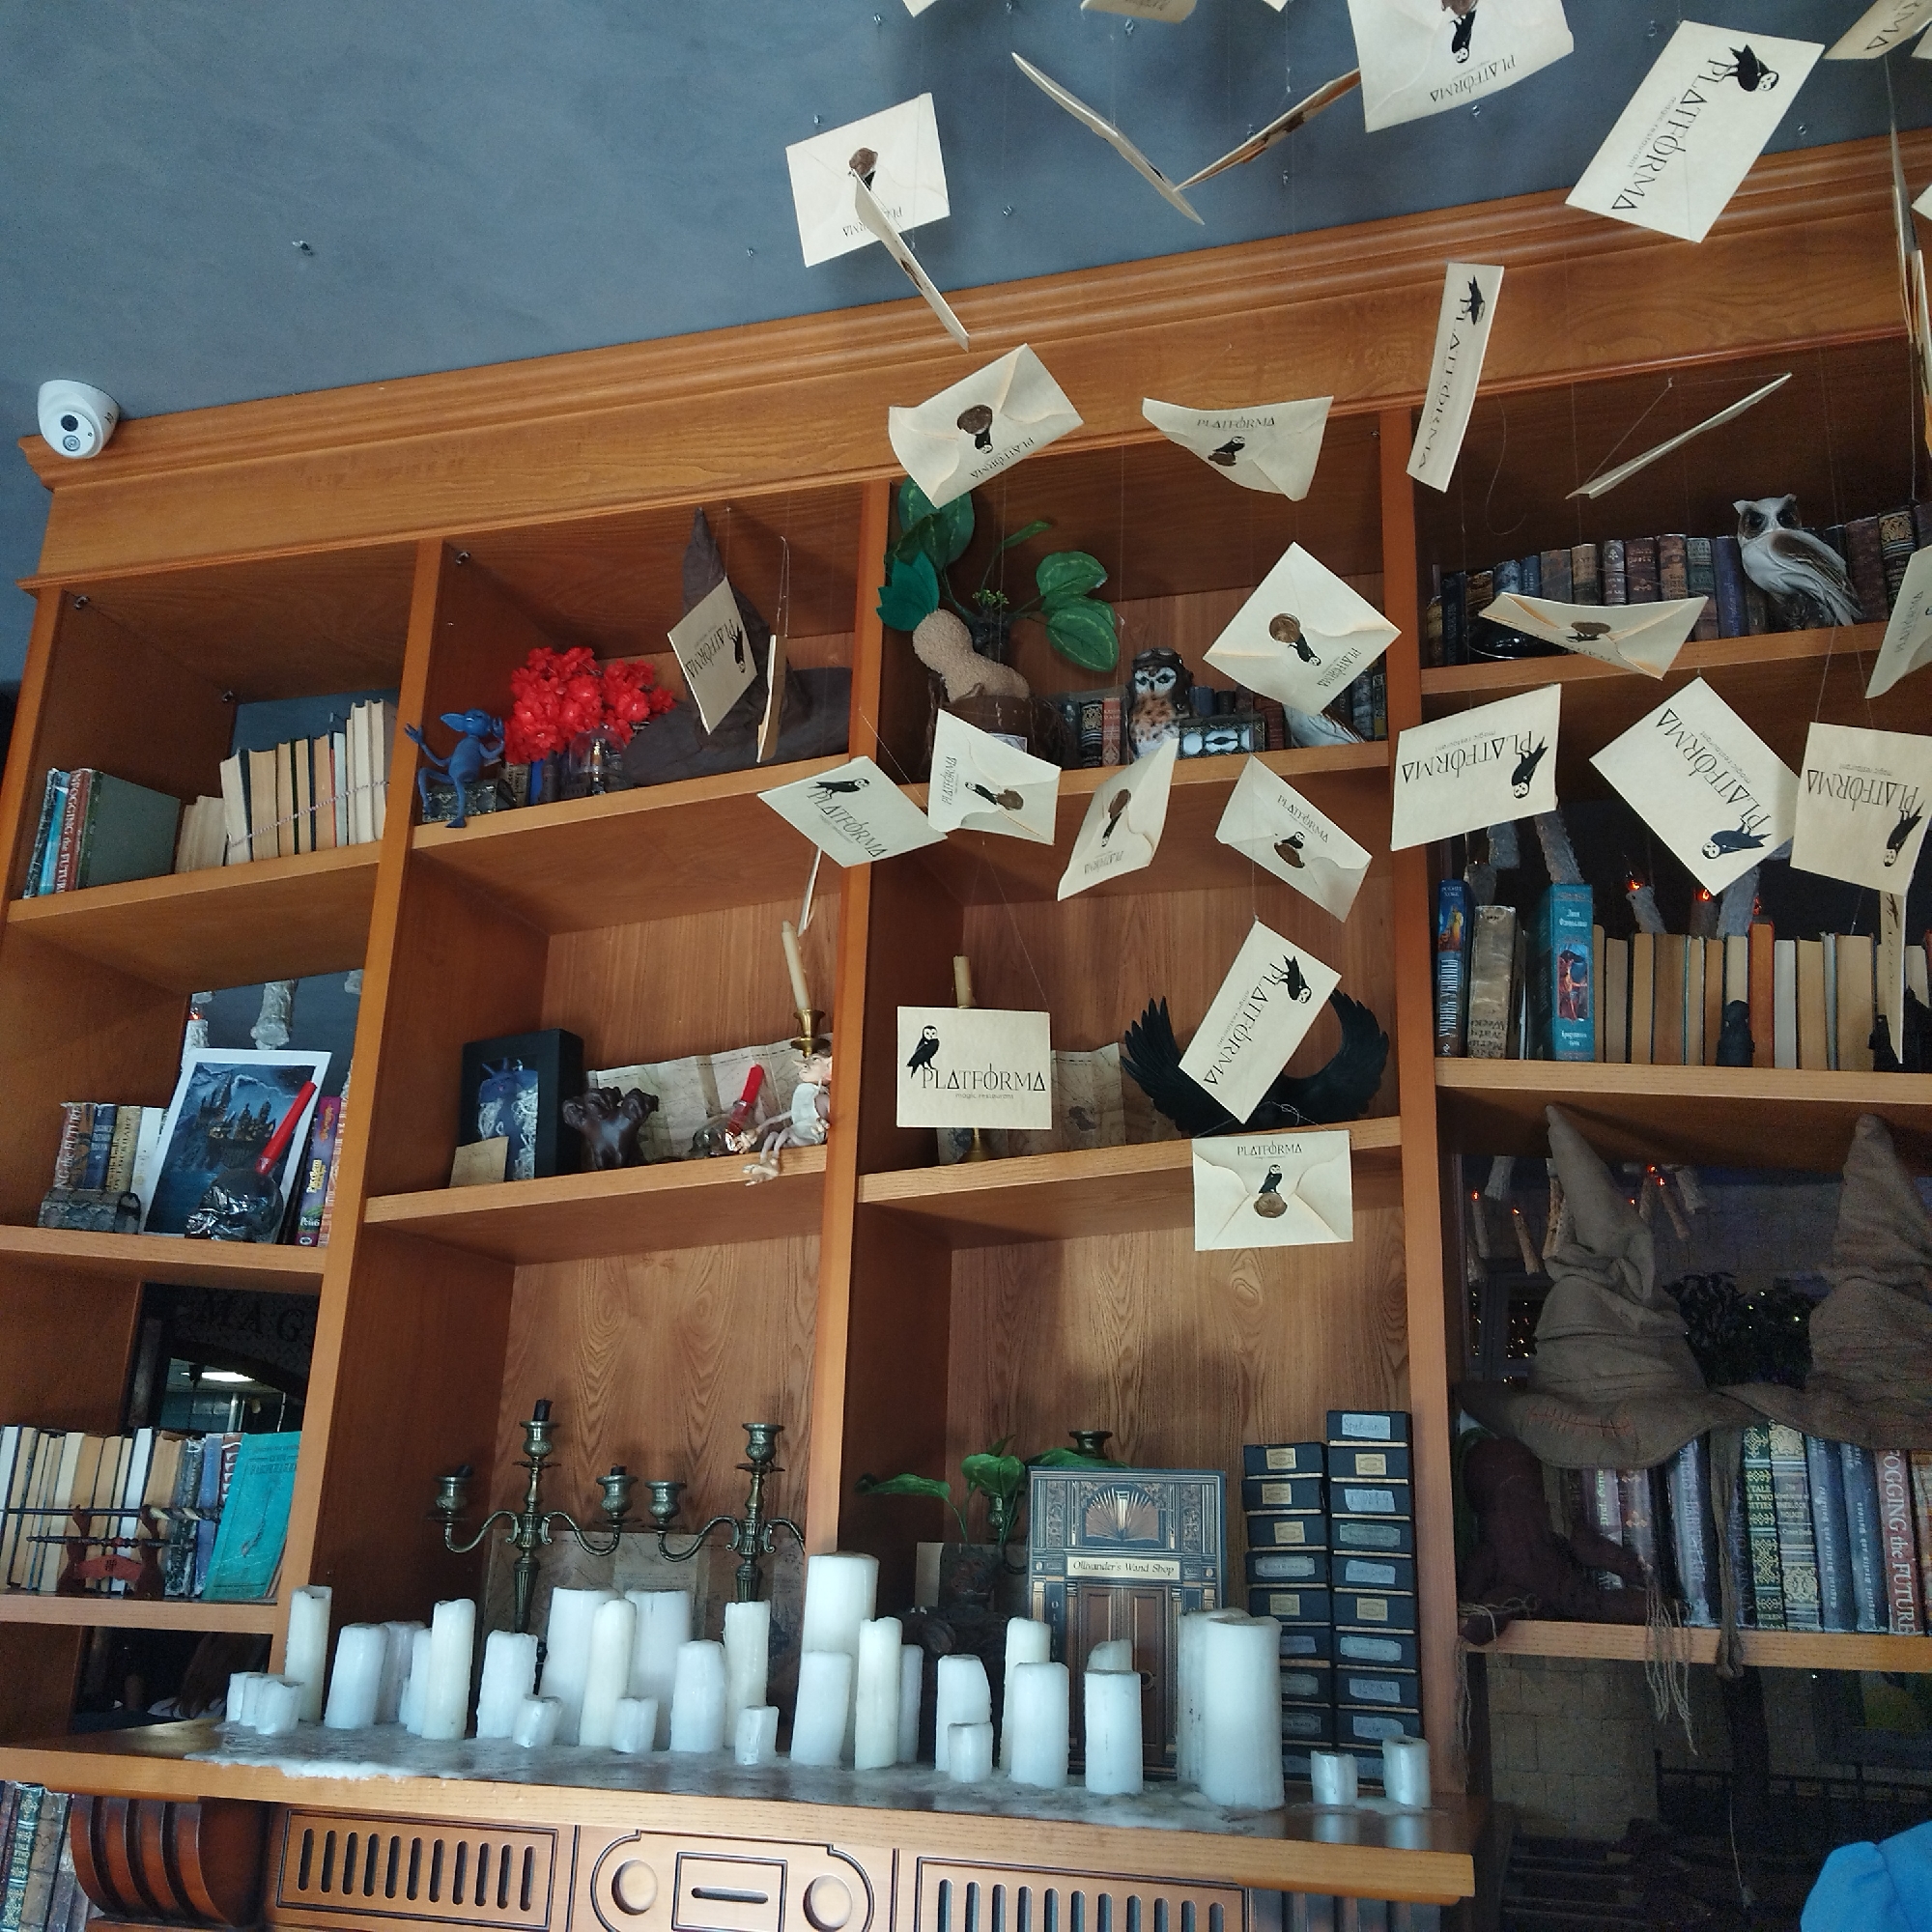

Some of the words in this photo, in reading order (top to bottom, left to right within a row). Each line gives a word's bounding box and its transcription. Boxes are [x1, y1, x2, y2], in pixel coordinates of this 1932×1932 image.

[1430, 54, 1517, 102] PLATFORMA
[1611, 58, 1739, 210] PLATFORMA
[1197, 415, 1276, 430] PLATFORMA
[1402, 730, 1533, 784] PLATFORMA
[1655, 707, 1772, 832] PLATFORMA
[1806, 769, 1920, 811] PLATFORMA
[806, 790, 889, 858] PLATFORMA
[1276, 793, 1329, 844] PLATFORMA
[1203, 962, 1284, 1086] PLATFORMA
[922, 1063, 1046, 1092] PLATFORMA
[1236, 1140, 1303, 1156] PLATFORMA
[1073, 1559, 1122, 1572] Ollivander's
[1125, 1562, 1150, 1573] Wand
[1151, 1563, 1175, 1576] Shop
[1889, 1535, 1908, 1559] the
[1892, 1561, 1917, 1633] FUTURE
